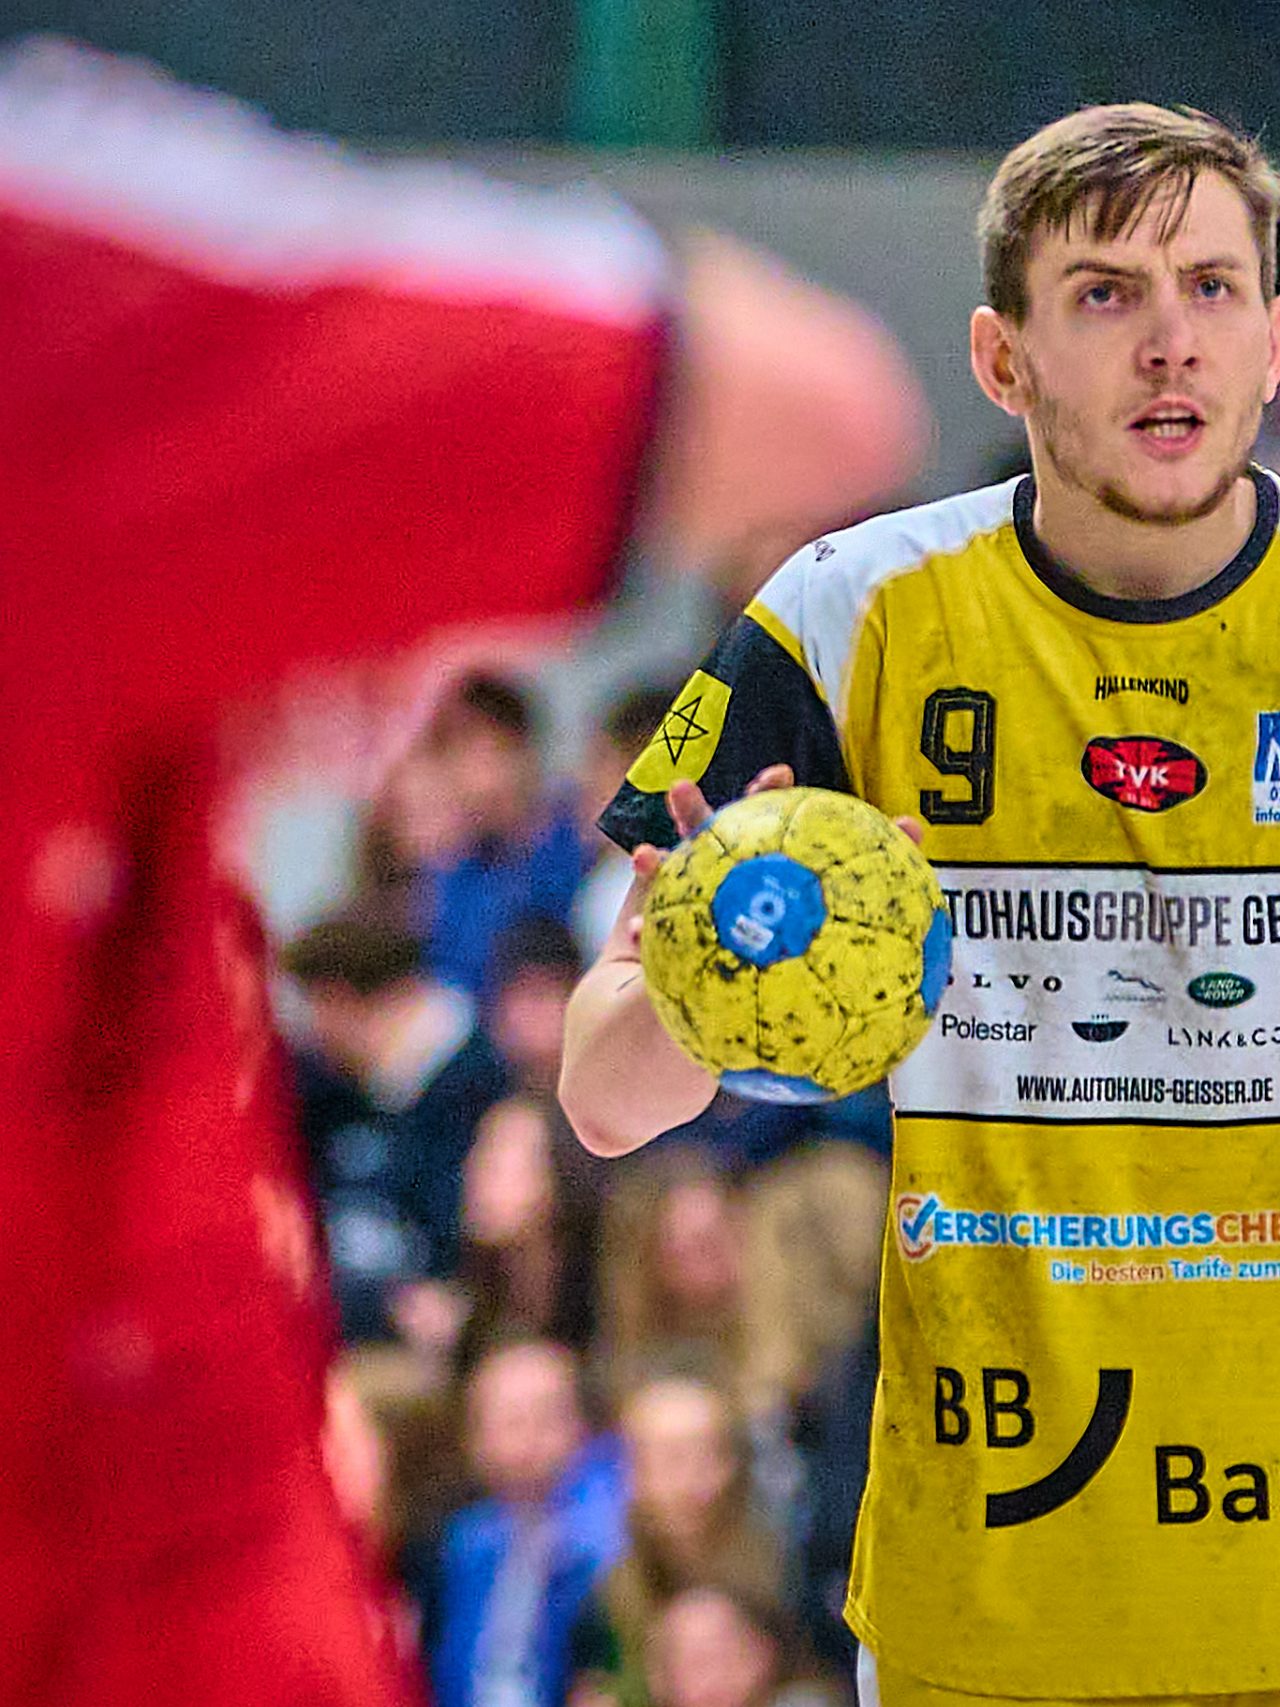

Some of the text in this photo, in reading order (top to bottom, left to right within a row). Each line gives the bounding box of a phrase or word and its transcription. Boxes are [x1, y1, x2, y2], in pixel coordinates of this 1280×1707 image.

[1095, 676, 1189, 704] HALLENKIND
[920, 687, 996, 824] 9
[942, 888, 1232, 946] TOHAUSGRUPPE
[948, 974, 1062, 992] LVO
[942, 1014, 1036, 1042] Polestar
[1017, 1075, 1273, 1106] WWW.AUTOHAUS-GEISSER.DE
[1052, 1261, 1086, 1281] Die
[1091, 1262, 1164, 1282] besten
[1171, 1258, 1232, 1280] Tarife
